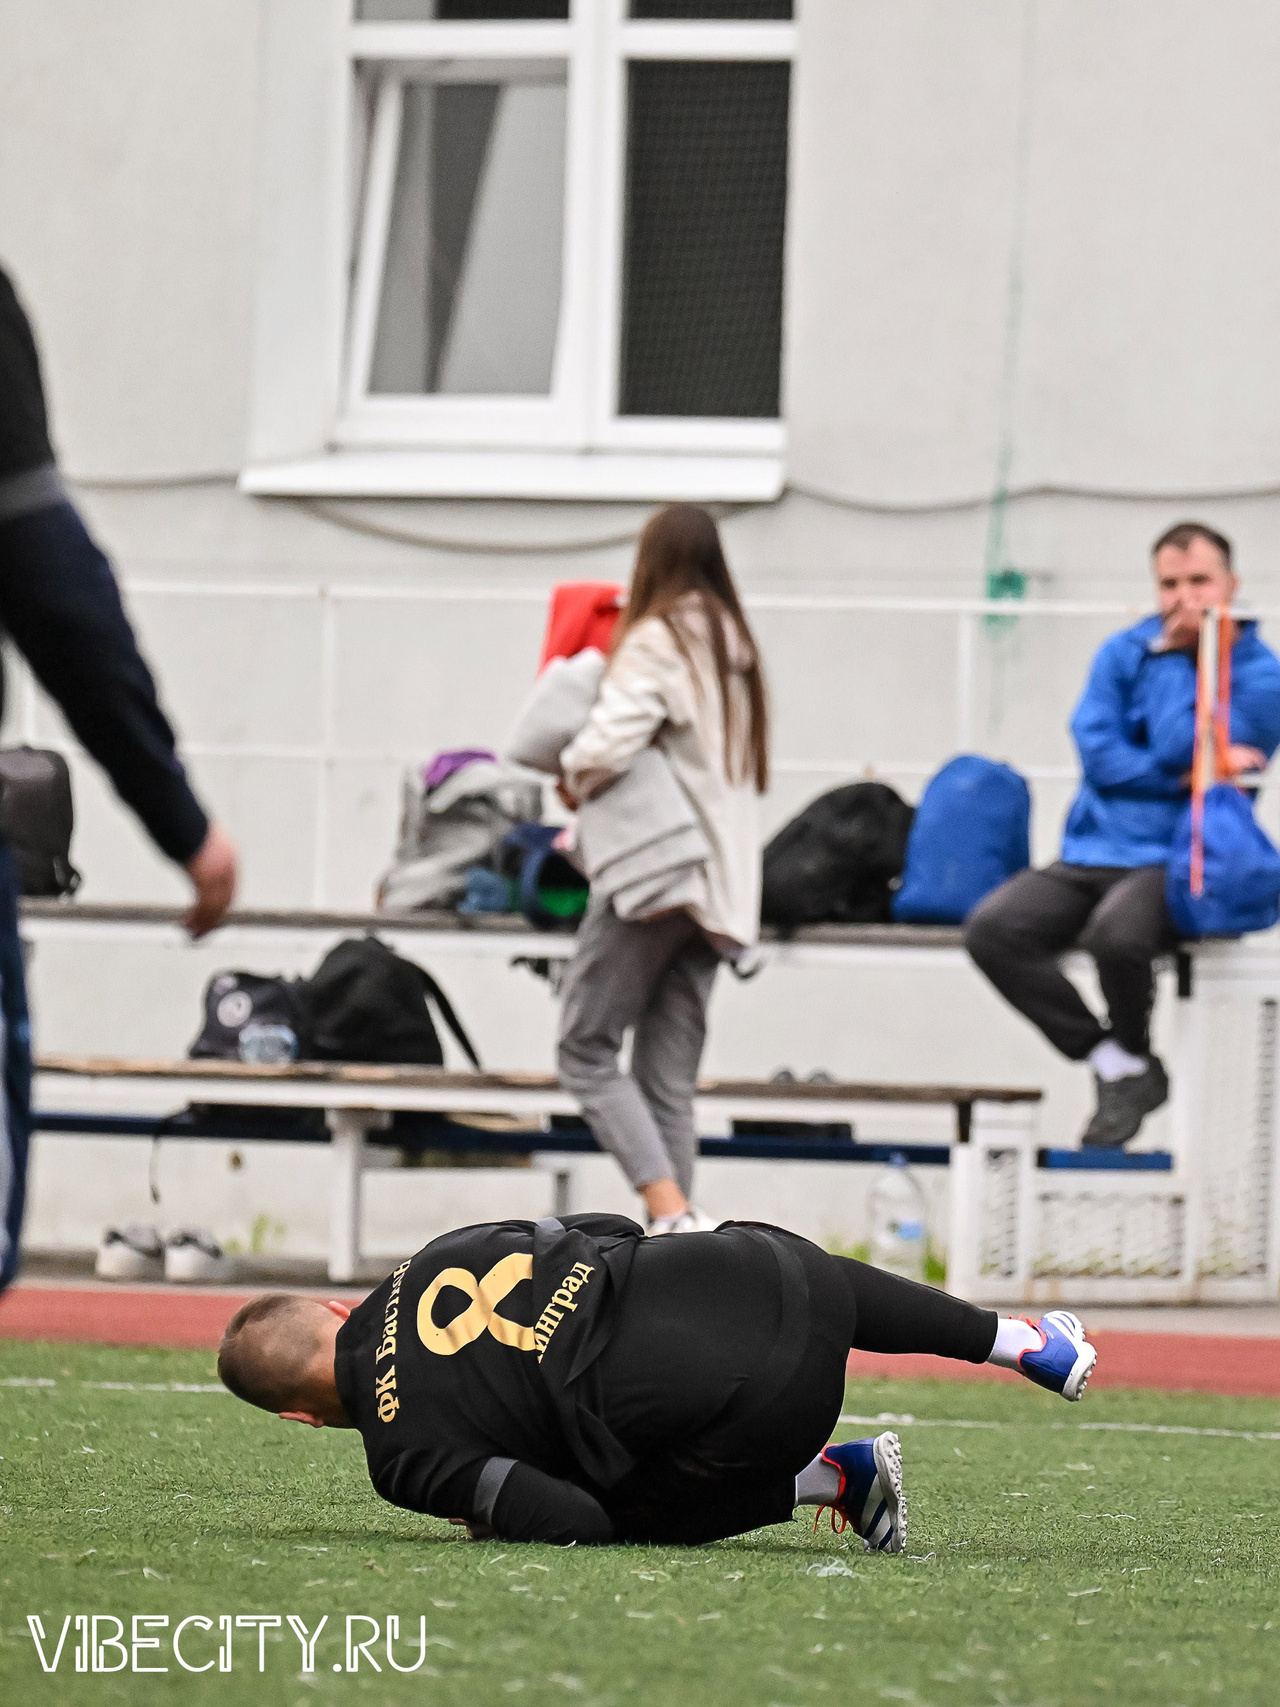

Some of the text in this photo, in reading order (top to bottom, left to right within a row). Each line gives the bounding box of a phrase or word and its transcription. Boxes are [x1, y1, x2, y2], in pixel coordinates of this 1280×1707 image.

[417, 1252, 538, 1356] 8
[533, 1261, 596, 1364] инград
[375, 1364, 400, 1423] ФК
